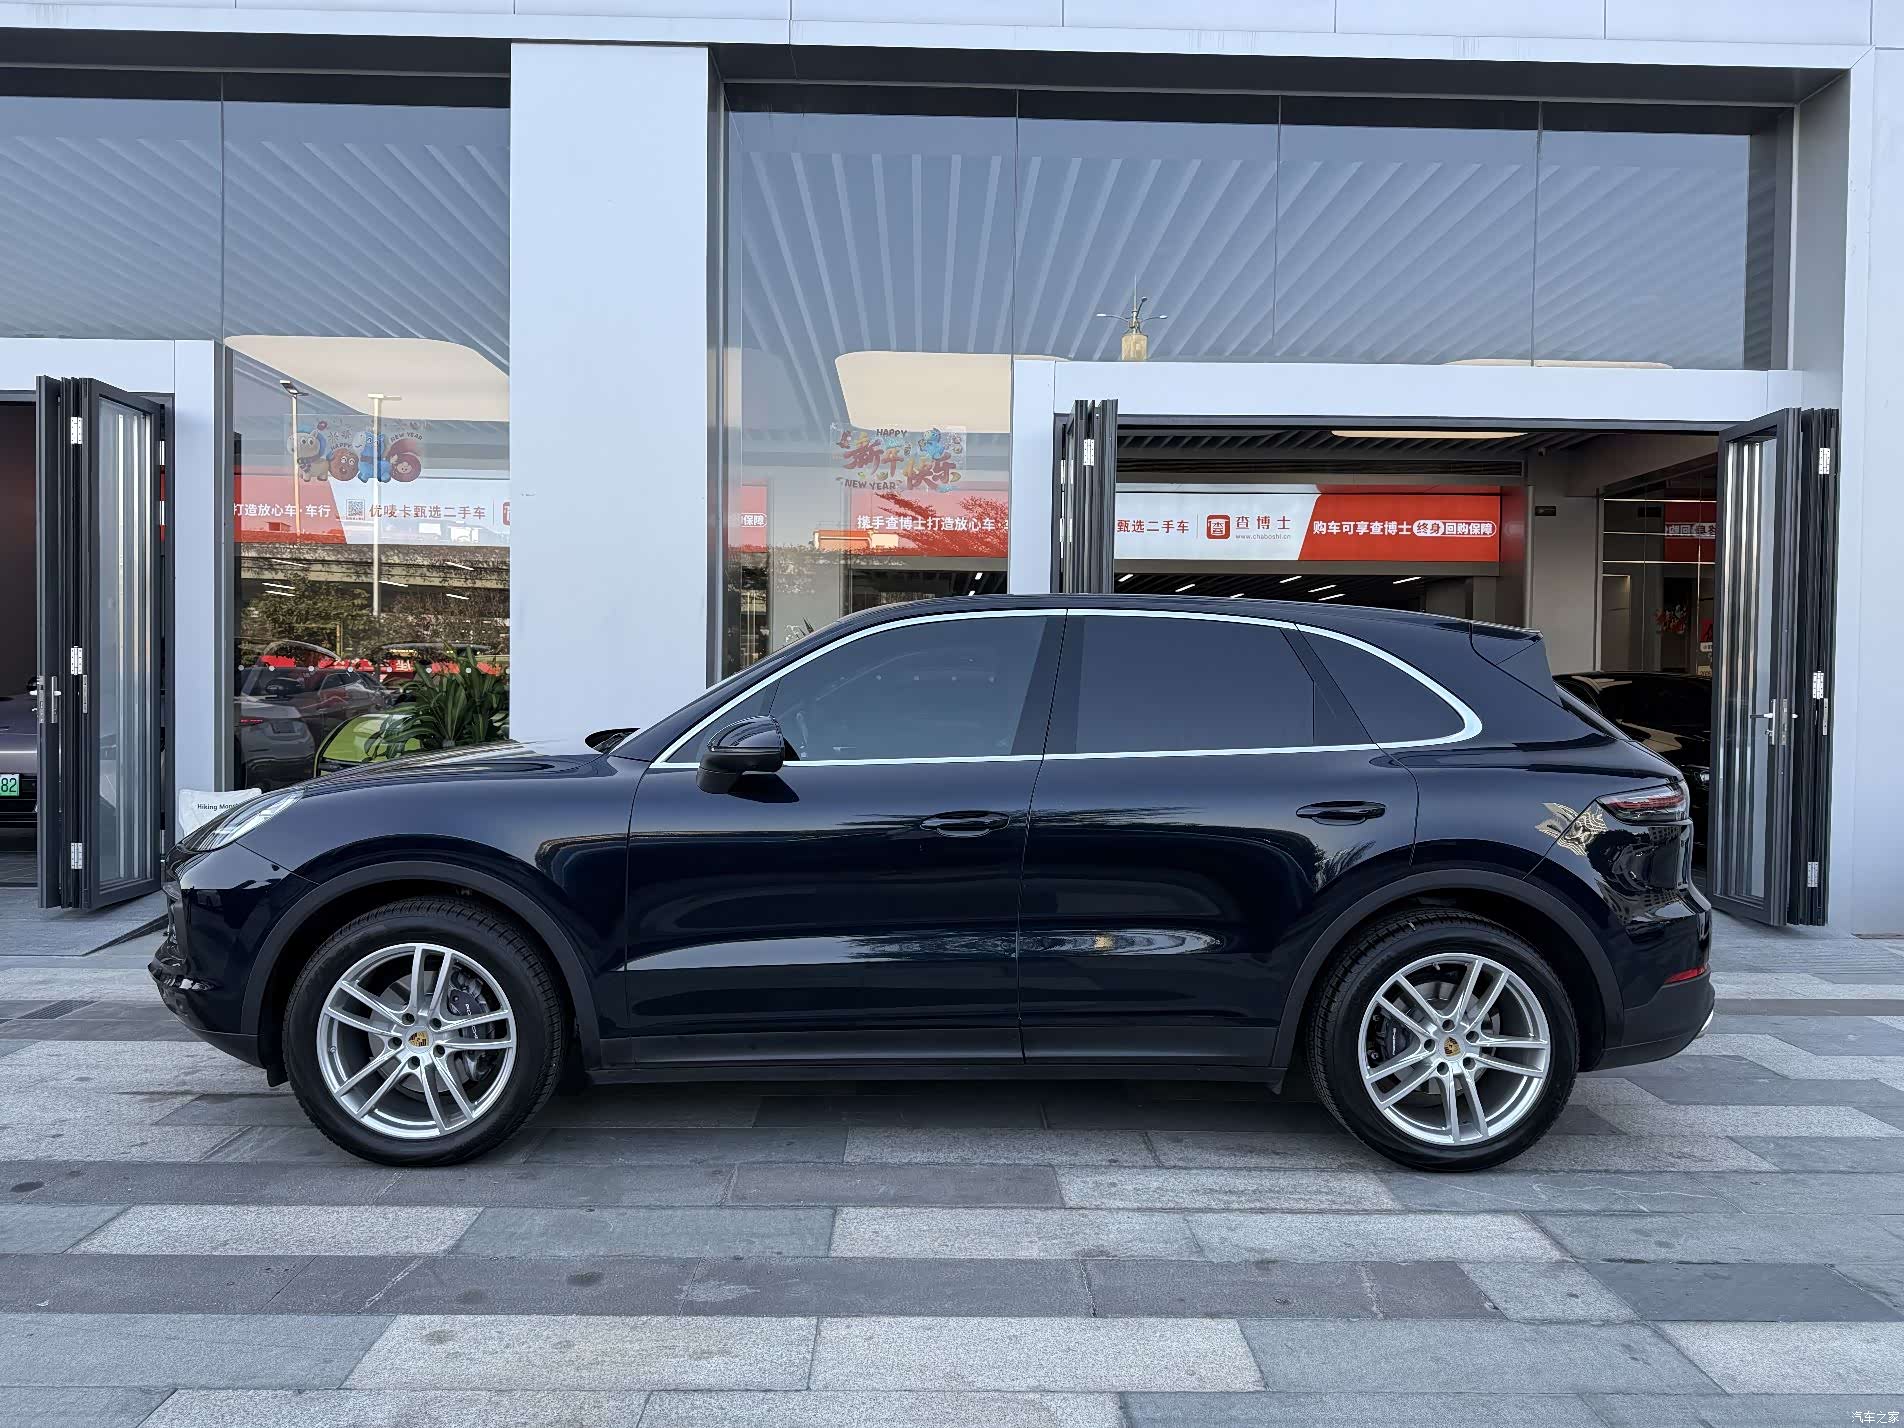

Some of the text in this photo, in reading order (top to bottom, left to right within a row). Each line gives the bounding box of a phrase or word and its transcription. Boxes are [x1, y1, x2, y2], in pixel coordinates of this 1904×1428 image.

[390, 431, 423, 443] NEW YEAR
[876, 428, 908, 437] HAPPY
[331, 441, 353, 451] HAPPY
[845, 479, 896, 490] NEW YEAR
[1117, 519, 1189, 533] 甄选二手车
[1, 778, 17, 793] 82
